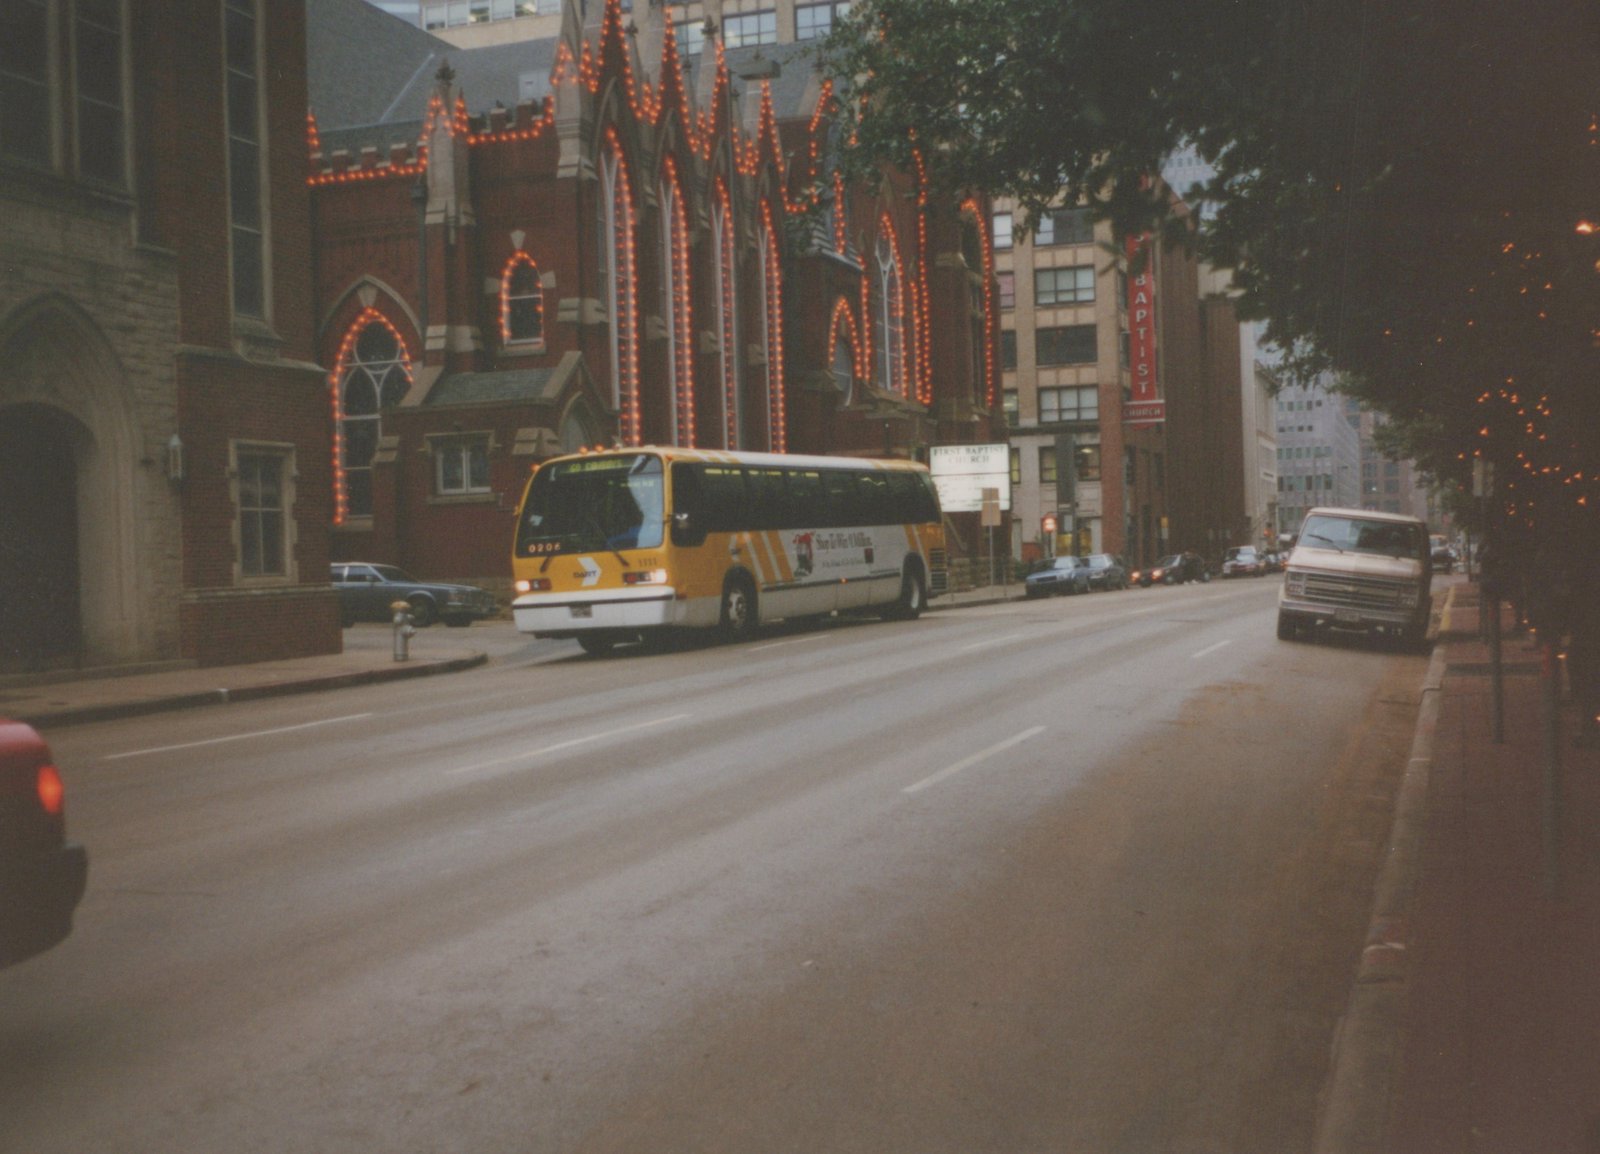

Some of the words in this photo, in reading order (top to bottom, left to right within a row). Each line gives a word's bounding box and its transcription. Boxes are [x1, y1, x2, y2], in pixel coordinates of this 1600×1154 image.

[1135, 274, 1149, 394] BAPTIST
[1124, 408, 1160, 417] CHURCH
[933, 447, 961, 457] FIRST
[965, 446, 1005, 455] BAPTIST
